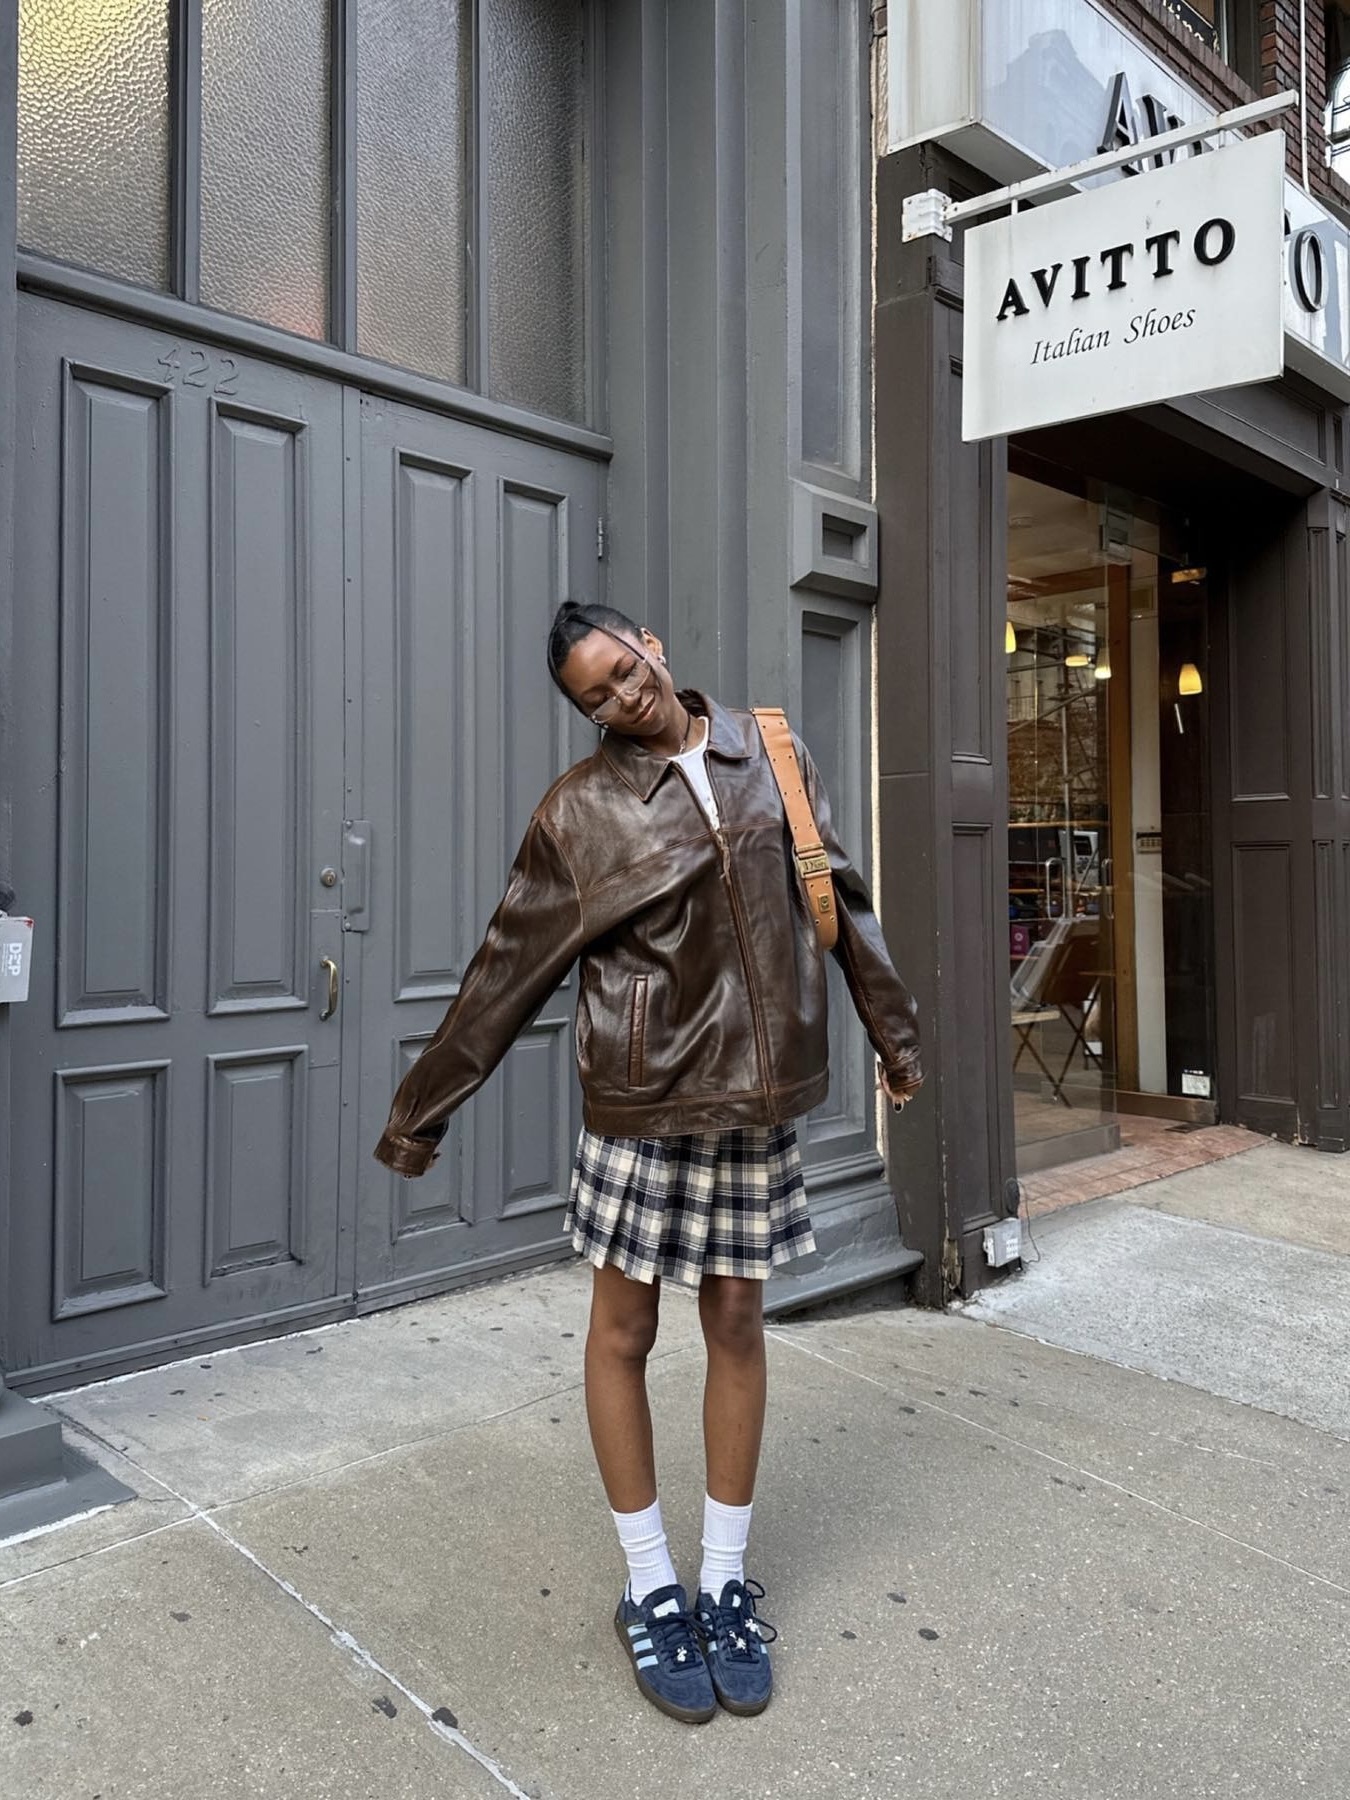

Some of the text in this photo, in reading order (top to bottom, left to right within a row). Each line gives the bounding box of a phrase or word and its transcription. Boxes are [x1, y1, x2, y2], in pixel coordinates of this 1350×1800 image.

[996, 217, 1236, 322] AVITTO
[1030, 308, 1197, 365] Italian Shoes
[157, 342, 239, 396] 422
